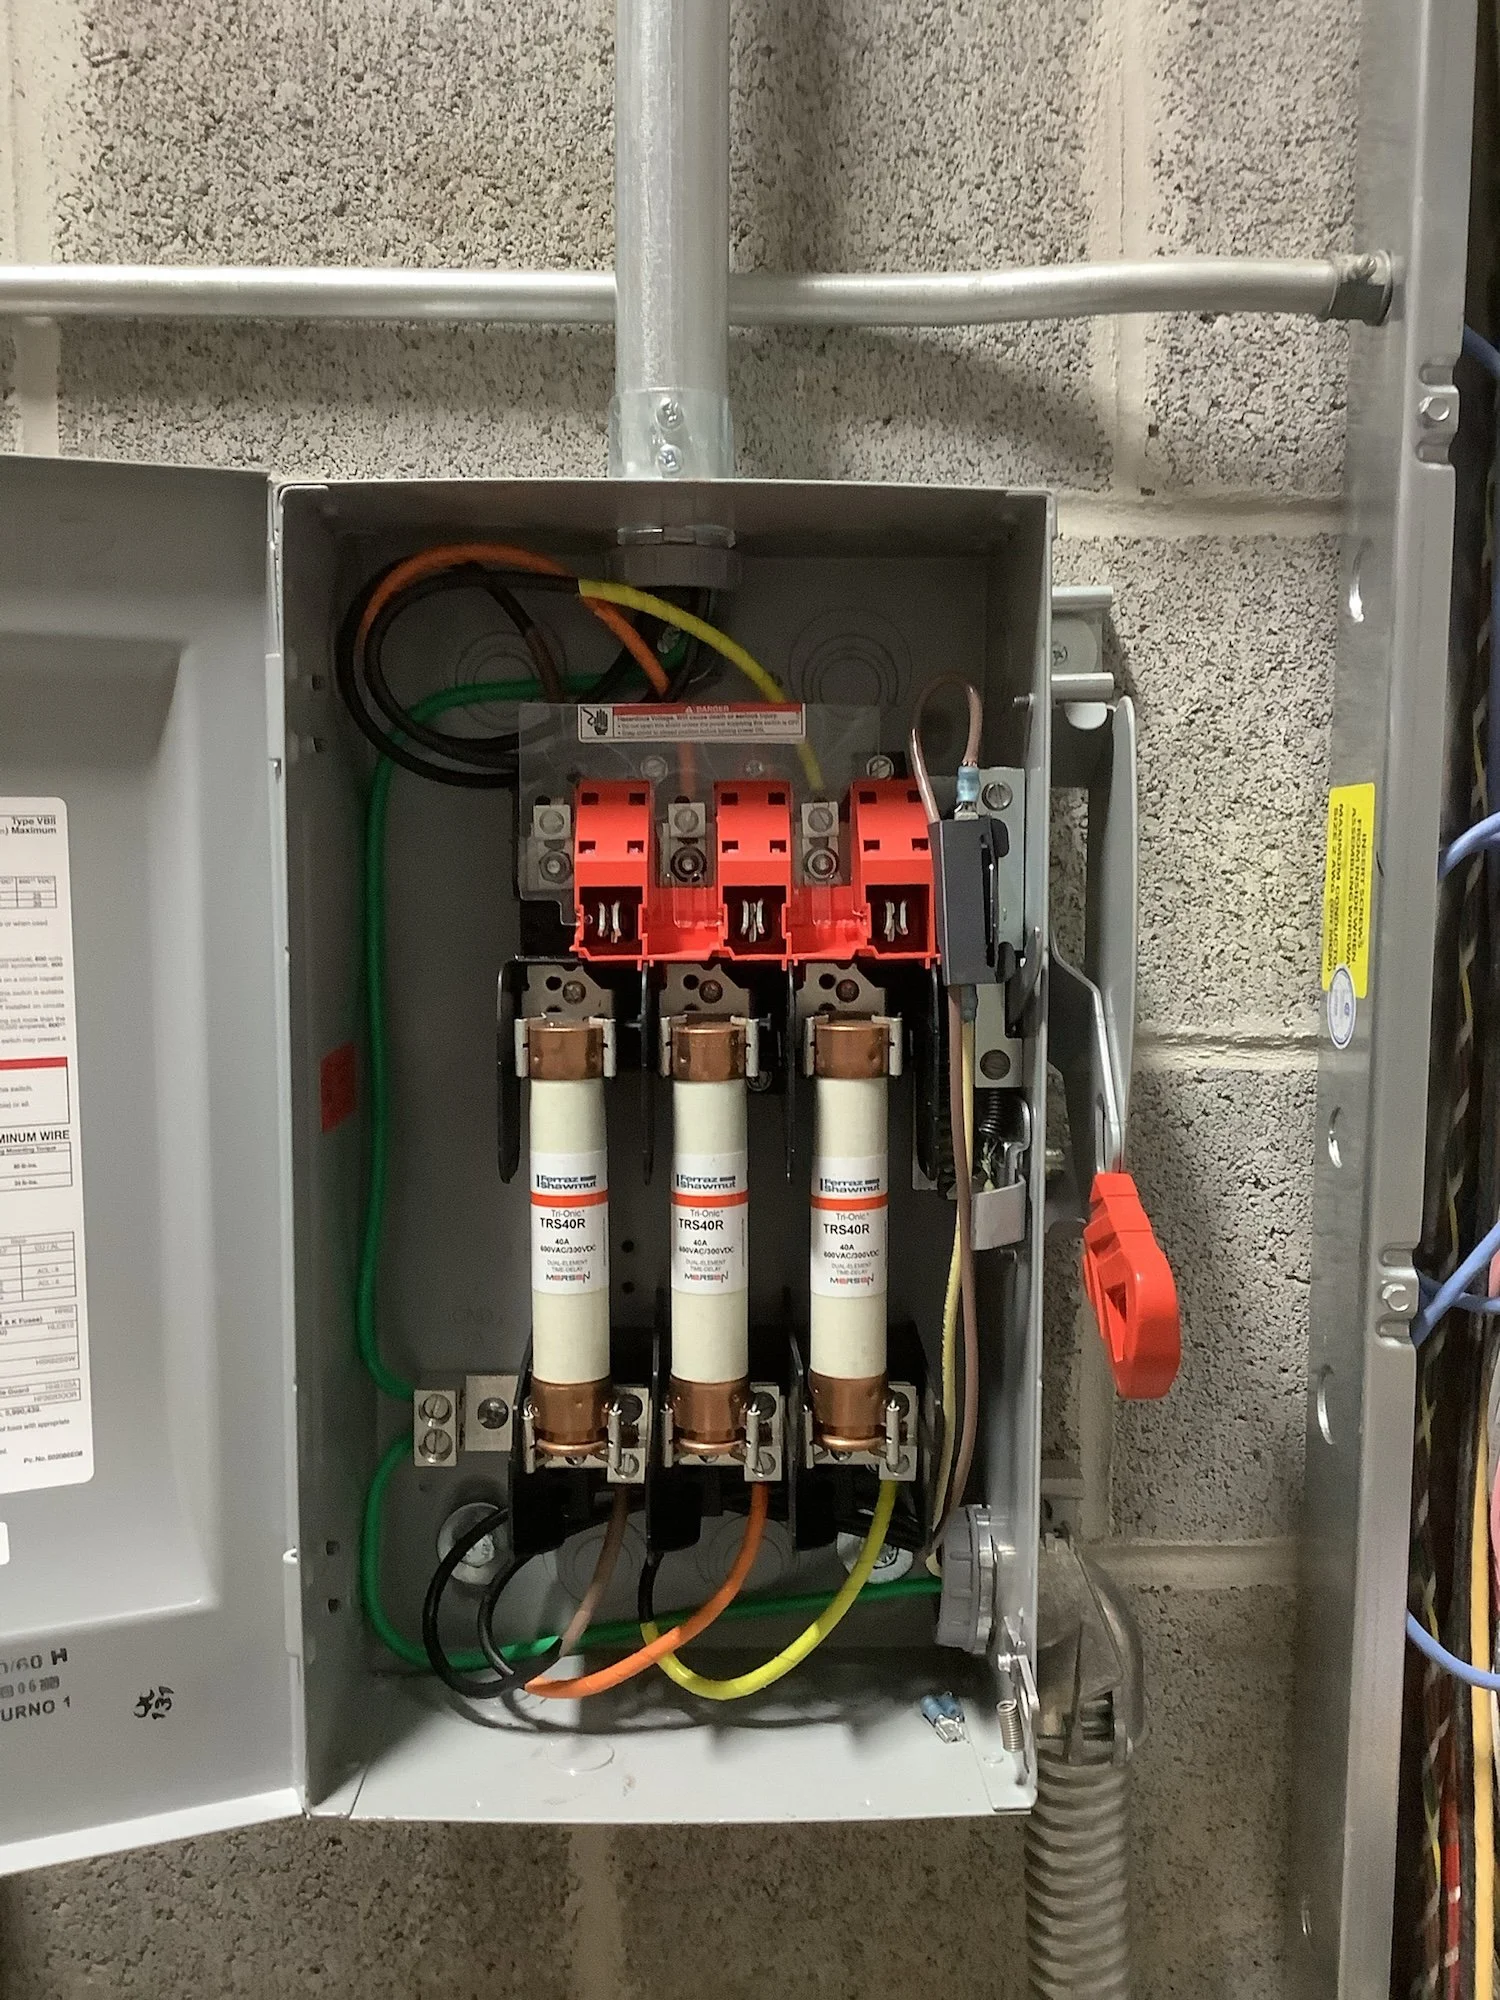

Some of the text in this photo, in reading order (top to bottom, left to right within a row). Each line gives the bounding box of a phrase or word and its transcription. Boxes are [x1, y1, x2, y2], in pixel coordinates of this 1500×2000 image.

[12, 816, 35, 827] Type
[11, 826, 57, 835] Maximum
[1336, 803, 1344, 881] MAXIMUM
[1348, 808, 1357, 902] ASSEMBLING
[1353, 866, 1361, 909] INSIDE
[1357, 833, 1367, 949] INSERT SCREWS
[1351, 911, 1359, 963] WHEN
[39, 1130, 70, 1141] WIRE
[540, 1175, 579, 1183] Ferraz
[680, 1175, 718, 1183] Ferraz
[824, 1179, 863, 1187] Ferraz
[540, 1181, 597, 1190] Shawmut
[680, 1181, 736, 1190] Shawmut
[824, 1185, 880, 1193] Shawmut
[540, 1218, 586, 1229] TRS40R
[679, 1218, 724, 1231] TRS40R
[824, 1224, 870, 1235] TRS40R
[540, 1244, 597, 1254] 600VAC/300VDC
[679, 1246, 735, 1256] 600VAC/300VDC
[824, 1250, 880, 1260] 600VAC/300VDC
[51, 1648, 68, 1666] H
[63, 1695, 71, 1708] 1
